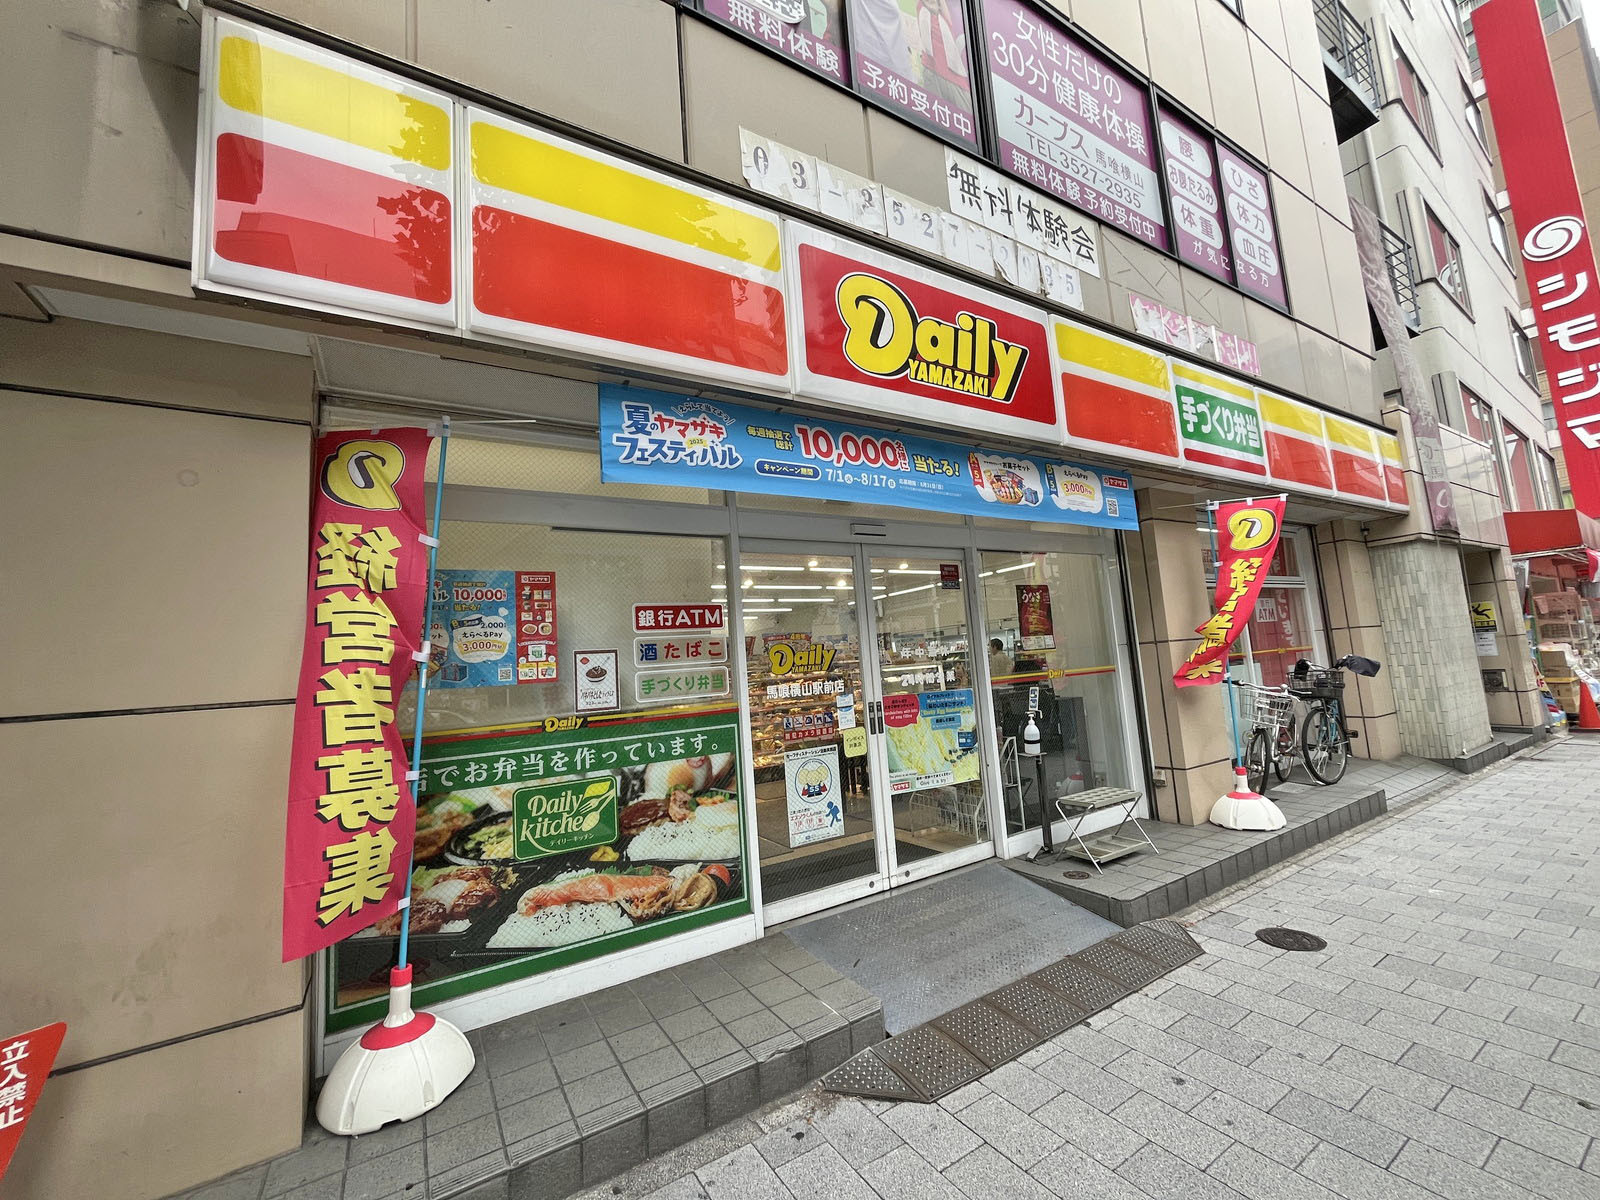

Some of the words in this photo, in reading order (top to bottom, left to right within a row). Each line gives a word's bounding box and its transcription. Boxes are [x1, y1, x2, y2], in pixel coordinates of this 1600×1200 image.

[727, 0, 840, 77] 無料体験
[863, 62, 972, 137] 予約受付中
[1012, 10, 1121, 104] 女性だけの
[992, 31, 1147, 157] 30分健康体操
[1231, 167, 1259, 200] ひざ
[1180, 204, 1215, 240] 体重
[1236, 202, 1265, 234] 体力
[1242, 238, 1271, 268] 血圧
[837, 273, 1028, 403] Daily
[909, 358, 991, 397] YAMAZAKI
[1181, 395, 1261, 449] 手づくり弁当
[615, 436, 740, 467] フェスティバル
[797, 427, 900, 467] 10,000
[453, 589, 502, 601] 10,000
[637, 608, 721, 627] 銀行ATM
[1258, 608, 1276, 621] ATM
[639, 643, 658, 662] 酒
[663, 640, 722, 660] たばこ
[769, 643, 837, 675] Daily
[641, 673, 724, 696] 手づくり弁当
[791, 664, 822, 674] YAMAZAKI
[766, 679, 845, 700] 馬喰横山駅前店
[544, 715, 584, 733] Daily
[527, 790, 584, 817] Daily
[0, 1040, 30, 1130] 立入禁止
